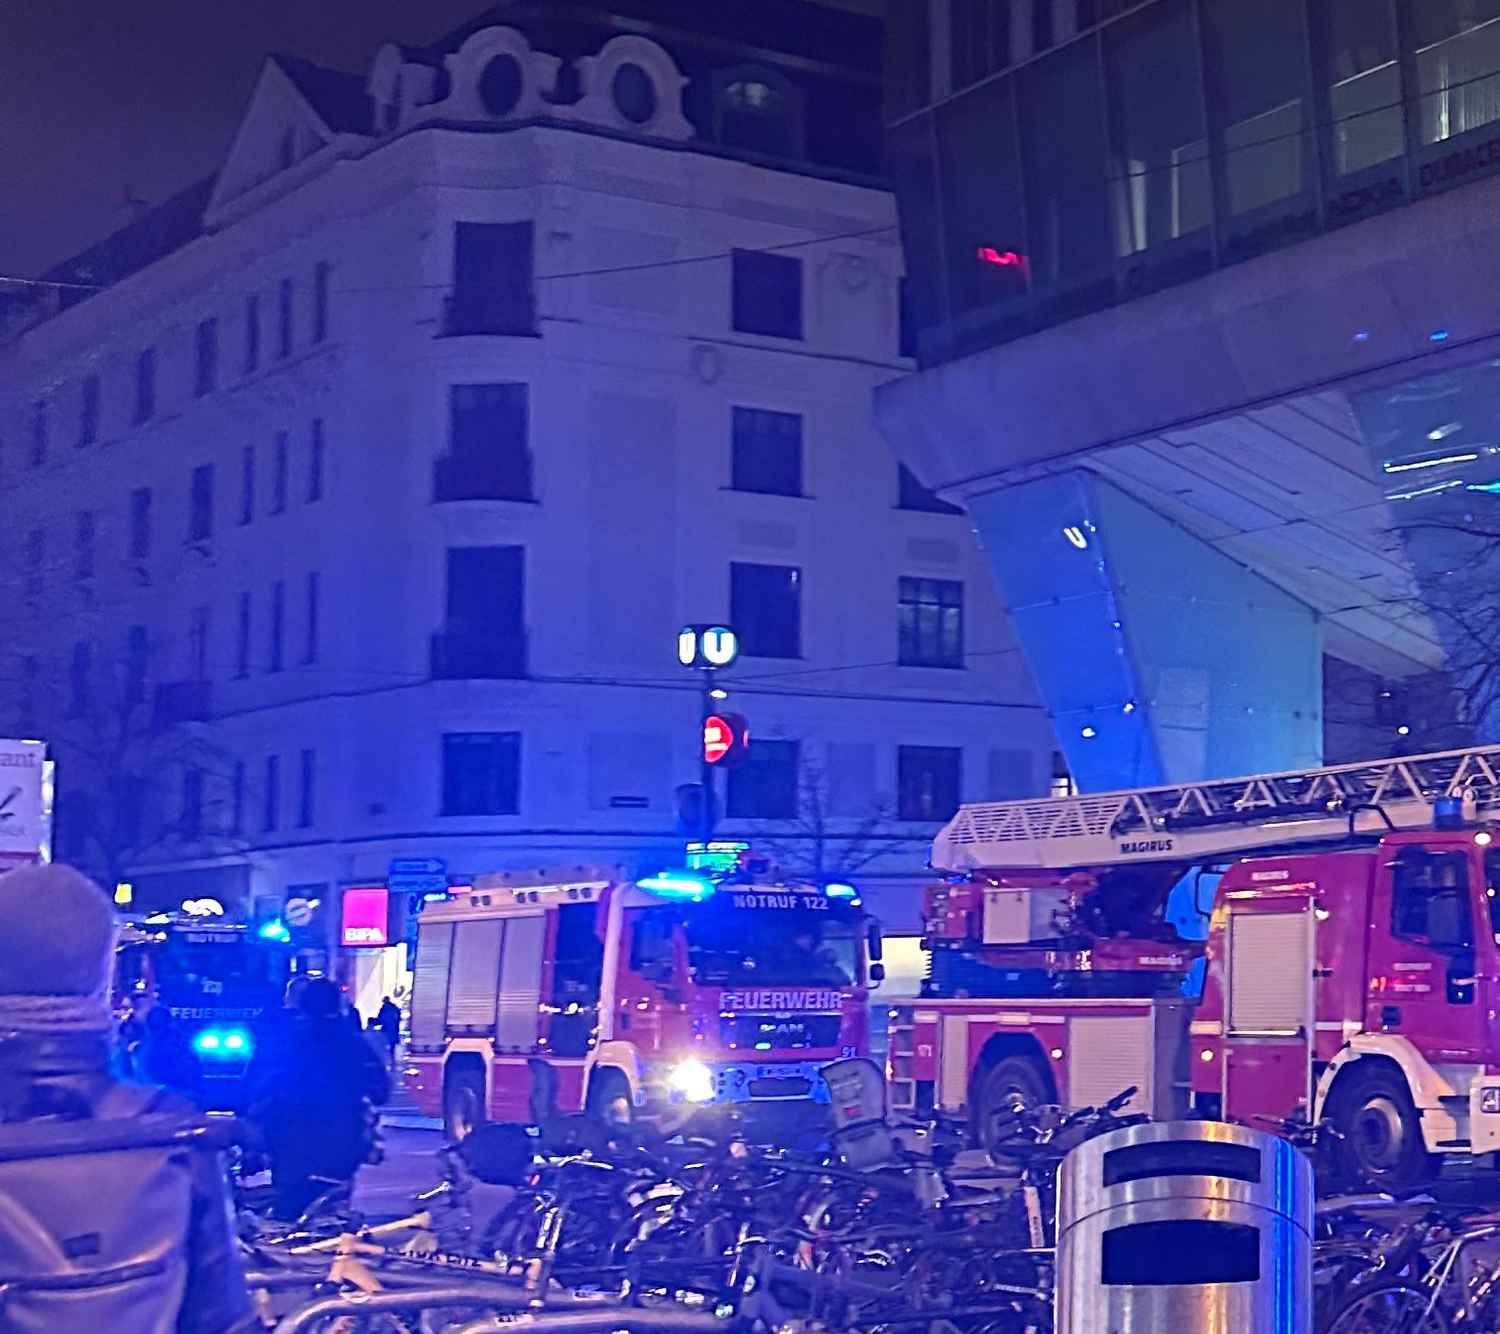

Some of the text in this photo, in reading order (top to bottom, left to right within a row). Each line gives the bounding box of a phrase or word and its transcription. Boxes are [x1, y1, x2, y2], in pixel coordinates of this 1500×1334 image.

[703, 630, 735, 665] U
[1120, 839, 1173, 854] MAGIRUS
[733, 895, 828, 909] NOTRUF 122
[345, 928, 383, 942] BIPA
[719, 992, 843, 1009] FEUERWEHR
